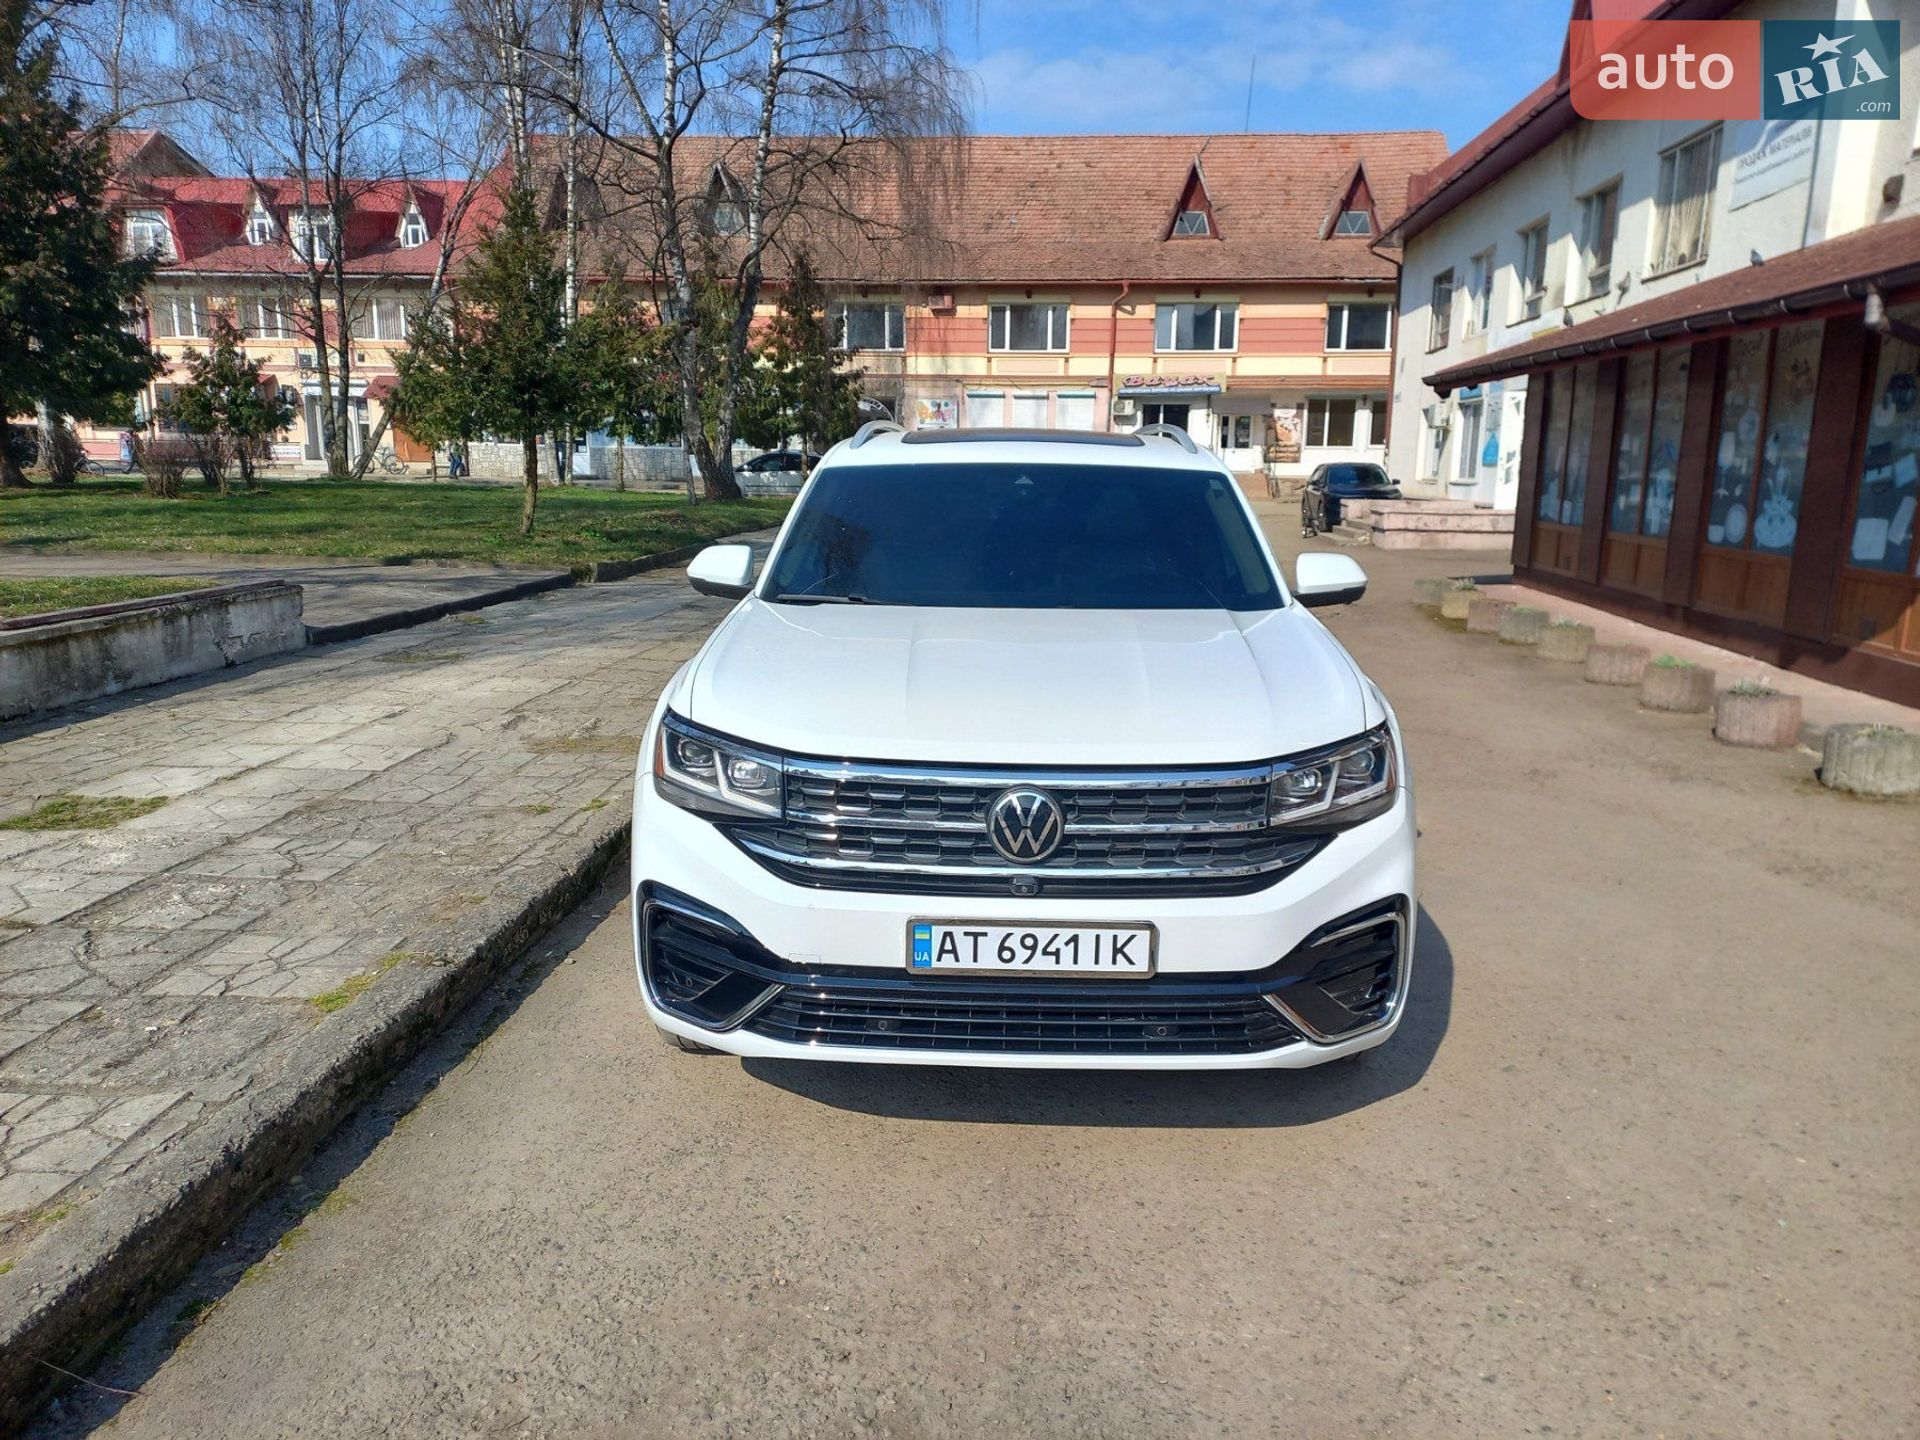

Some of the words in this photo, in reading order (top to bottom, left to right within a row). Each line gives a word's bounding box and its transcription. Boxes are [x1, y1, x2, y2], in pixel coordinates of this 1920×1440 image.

[914, 952, 930, 962] UA
[936, 931, 988, 963] AT
[997, 932, 1080, 966] 6941
